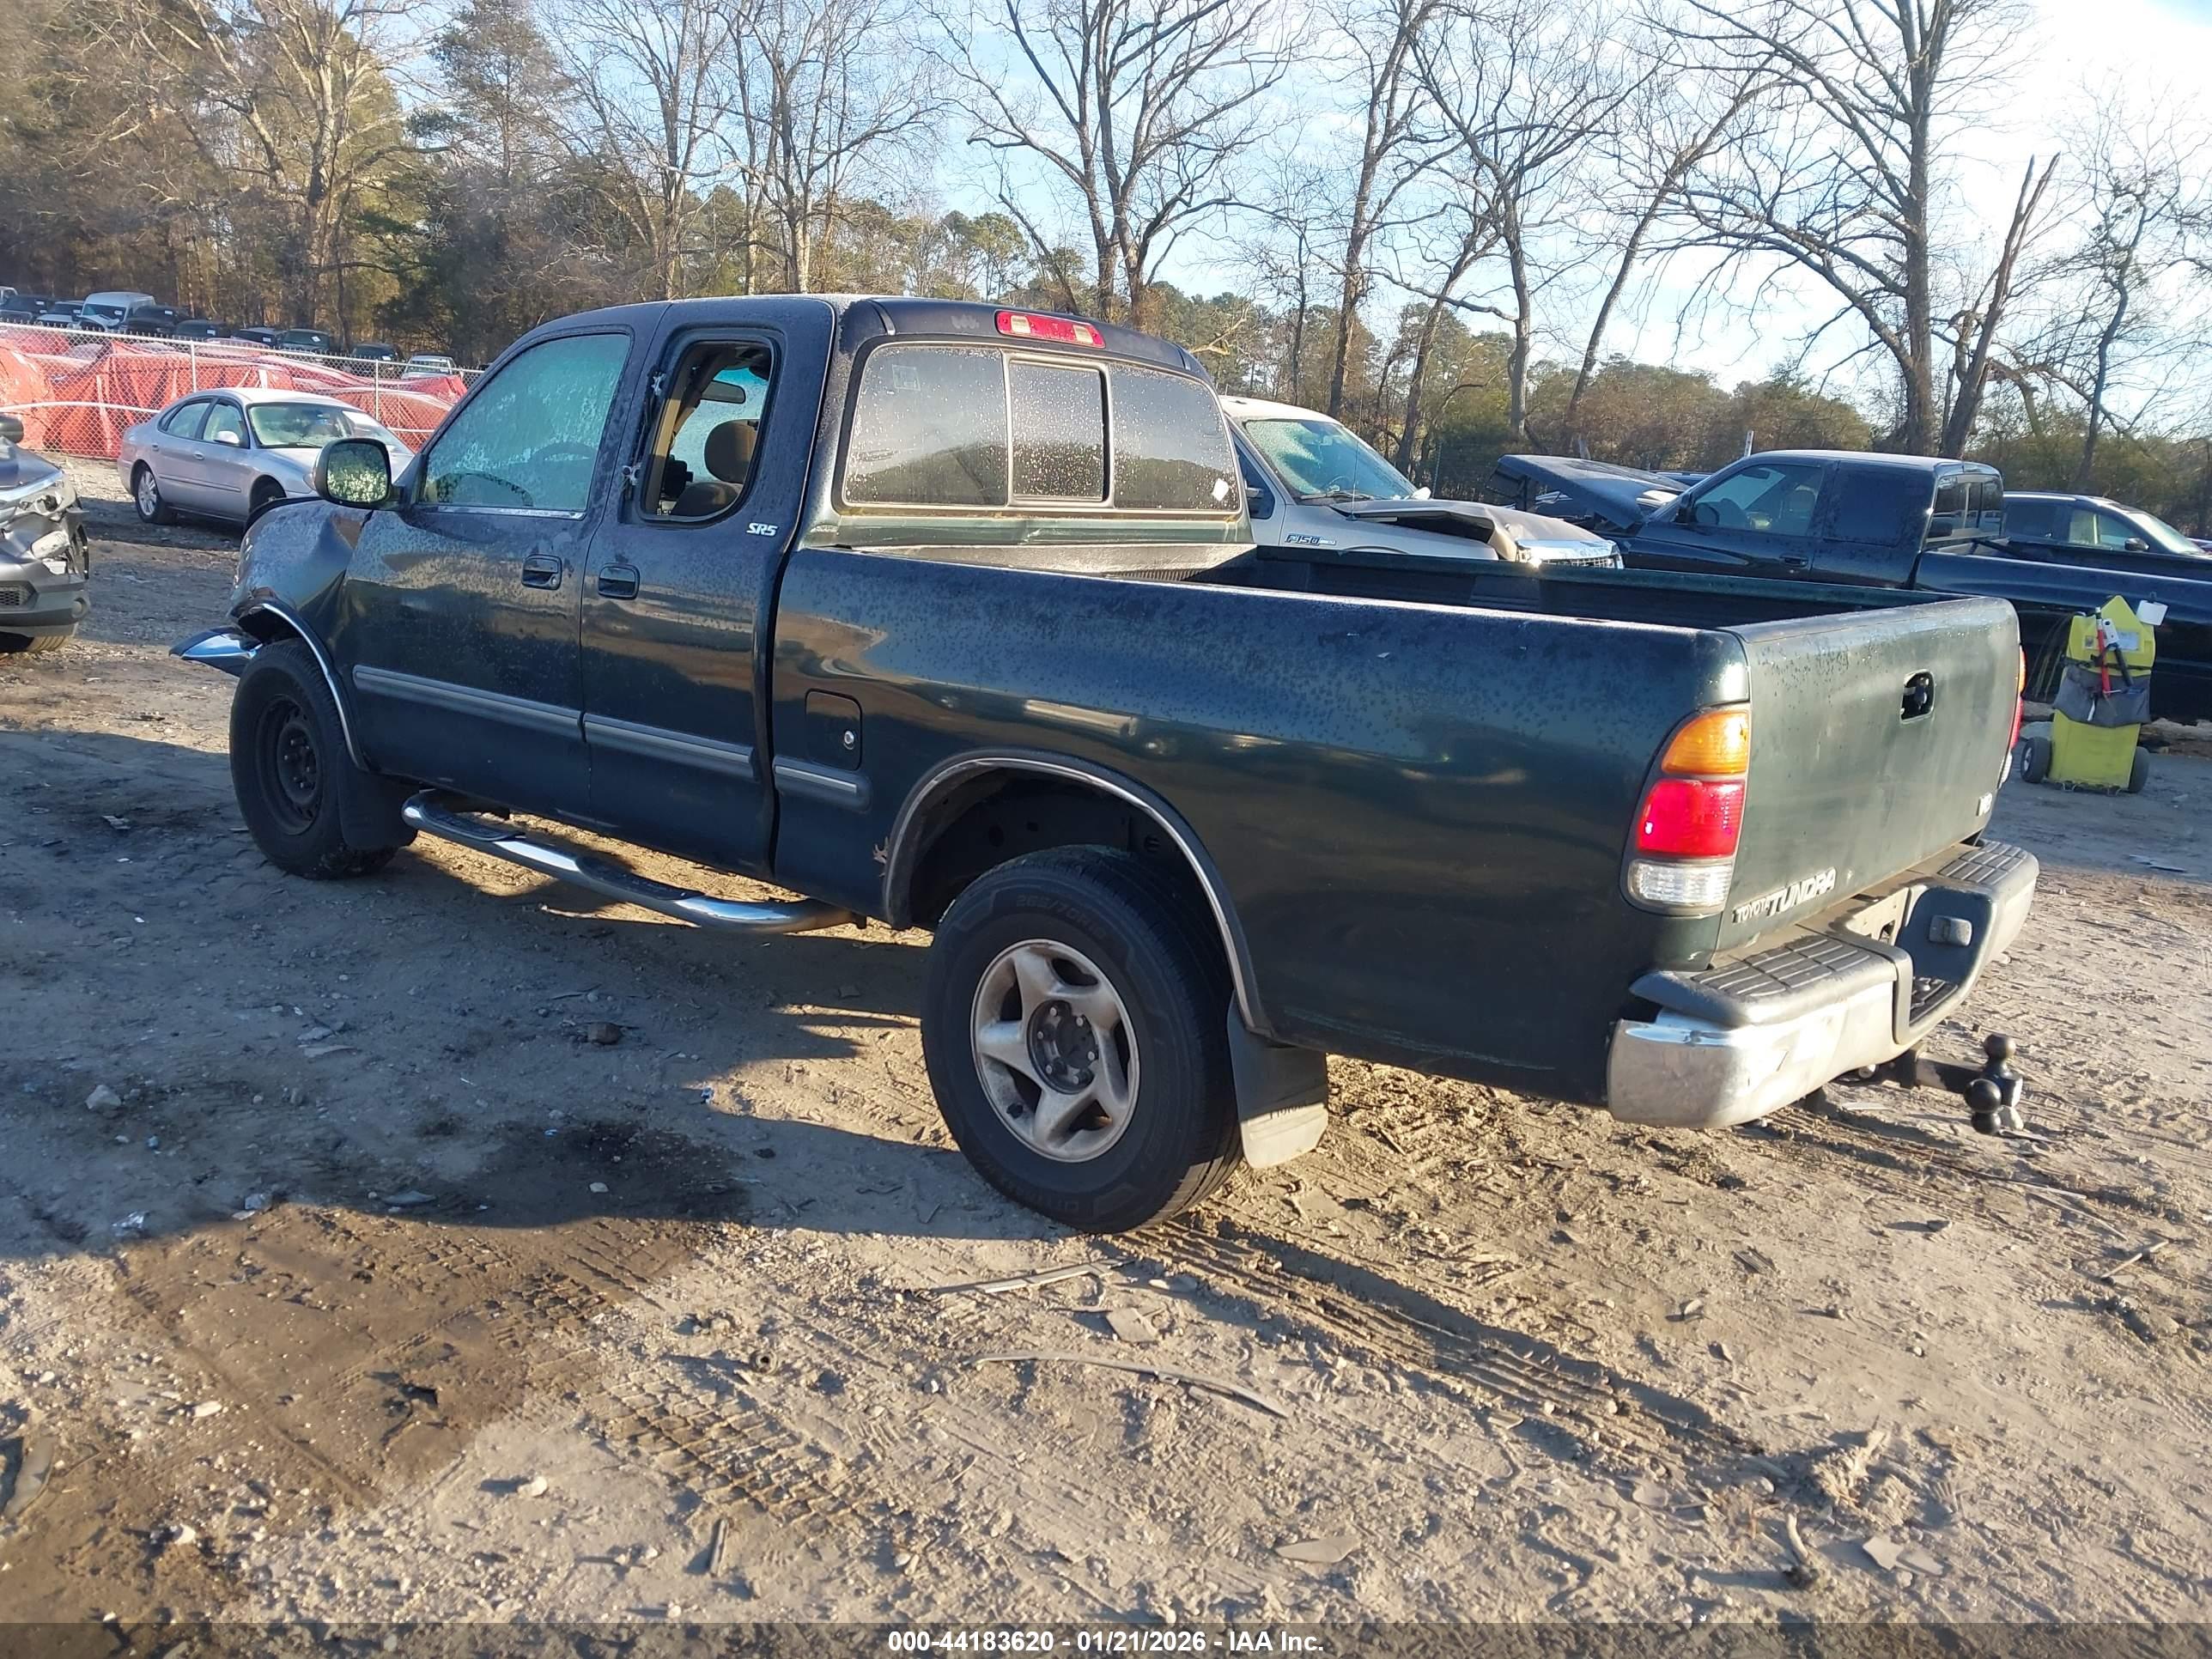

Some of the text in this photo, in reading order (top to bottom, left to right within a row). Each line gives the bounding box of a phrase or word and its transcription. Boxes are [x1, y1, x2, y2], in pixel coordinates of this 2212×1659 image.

[745, 522, 778, 537] SR5
[1735, 868, 1837, 923] TOYOTA TUNDRA
